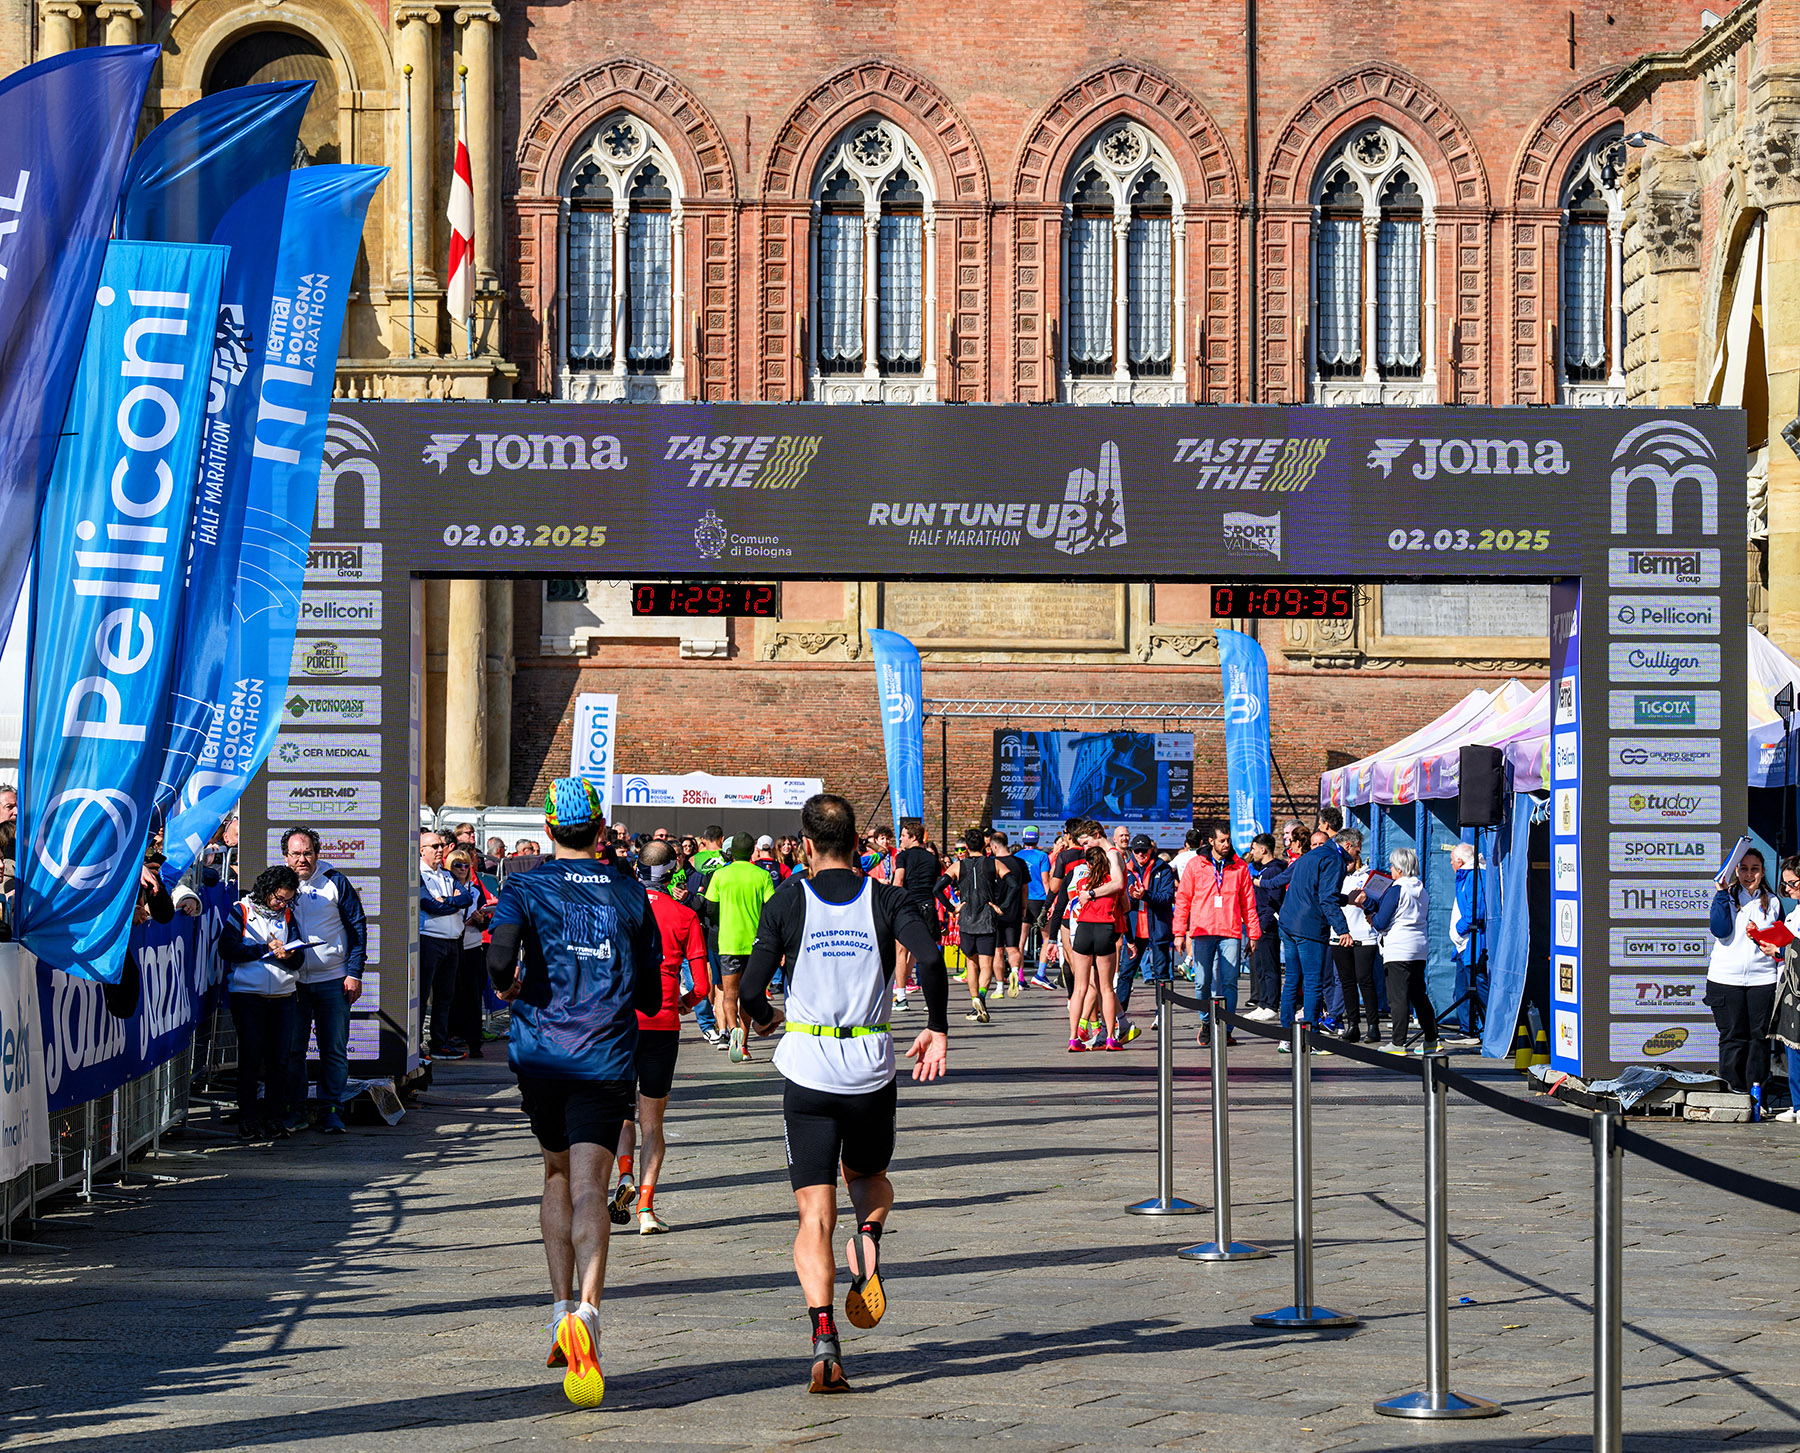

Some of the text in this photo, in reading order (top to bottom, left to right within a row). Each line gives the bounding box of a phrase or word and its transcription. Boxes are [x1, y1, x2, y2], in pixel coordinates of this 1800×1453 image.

[286, 273, 315, 366] BOLOGNA
[302, 273, 331, 368] ARATHON
[664, 435, 776, 460] TASTE
[1173, 438, 1285, 463] TASTE
[207, 420, 231, 497] MARATHON
[686, 463, 761, 488] THE
[1196, 466, 1270, 490] THE
[62, 286, 190, 742] Pelliconi
[199, 498, 220, 546] HALF
[868, 503, 1088, 540] RUN TUNE UP
[442, 524, 608, 547] 02.03.2025
[730, 534, 779, 545] Comune
[908, 530, 1021, 546] HALF MARATHON
[1223, 526, 1276, 538] SPORT
[1387, 529, 1550, 551] 02.03.2025
[730, 546, 793, 559] di Bologna
[1223, 538, 1276, 551] VALLEY
[306, 546, 363, 569] ermal
[1628, 551, 1701, 574] Termal
[337, 569, 363, 579] Group
[1676, 575, 1701, 584] Group
[636, 586, 772, 614] 01:29:12
[1214, 588, 1349, 616] 01:09:35
[302, 602, 373, 618] Pelliconi
[1641, 607, 1712, 624] Pelliconi
[1628, 650, 1700, 676] Culligan
[308, 700, 365, 712] TECNOCASA
[220, 678, 249, 771] BOLOGNA
[237, 678, 265, 772] ARATHON
[303, 748, 370, 757] CER MEDICAL
[1000, 775, 1041, 783] 02.03.2025
[1001, 785, 1028, 793] TASTE
[682, 797, 717, 805] PORTICI
[1647, 794, 1701, 811] tuday
[1624, 843, 1705, 855] SPORTLAB
[1660, 889, 1700, 898] HOTELS
[1701, 889, 1709, 898] &
[1660, 900, 1709, 909] RESORTS
[810, 930, 869, 940] POLISPORTIVA
[806, 940, 873, 953] PORTA SARAGOZZA
[1629, 943, 1701, 952] GYM TO GO
